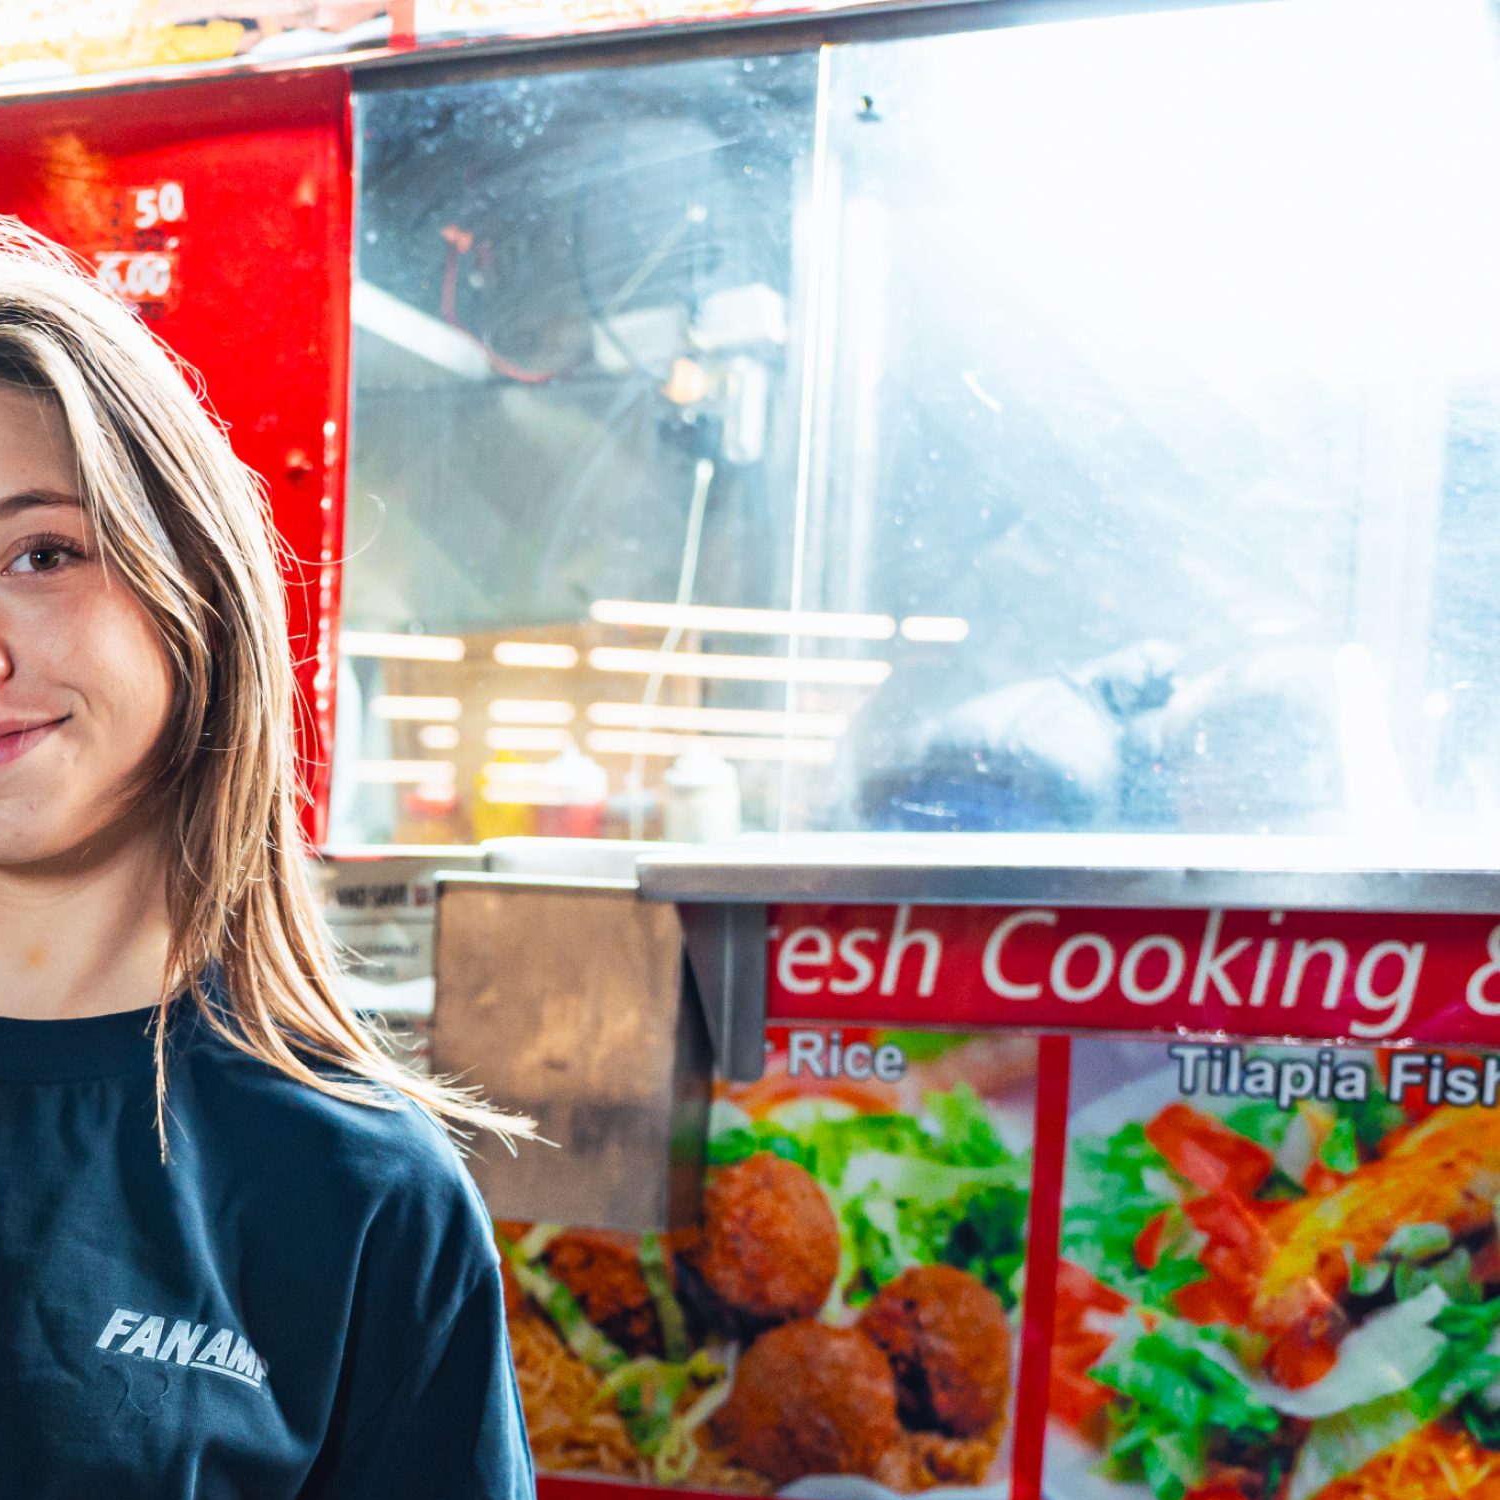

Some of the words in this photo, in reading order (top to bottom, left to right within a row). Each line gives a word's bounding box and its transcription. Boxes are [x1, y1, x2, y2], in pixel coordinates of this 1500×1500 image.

[770, 904, 941, 997] esh
[982, 909, 1427, 1038] Cooking
[788, 1031, 906, 1082] Rice
[1171, 1045, 1368, 1110] Tilapia
